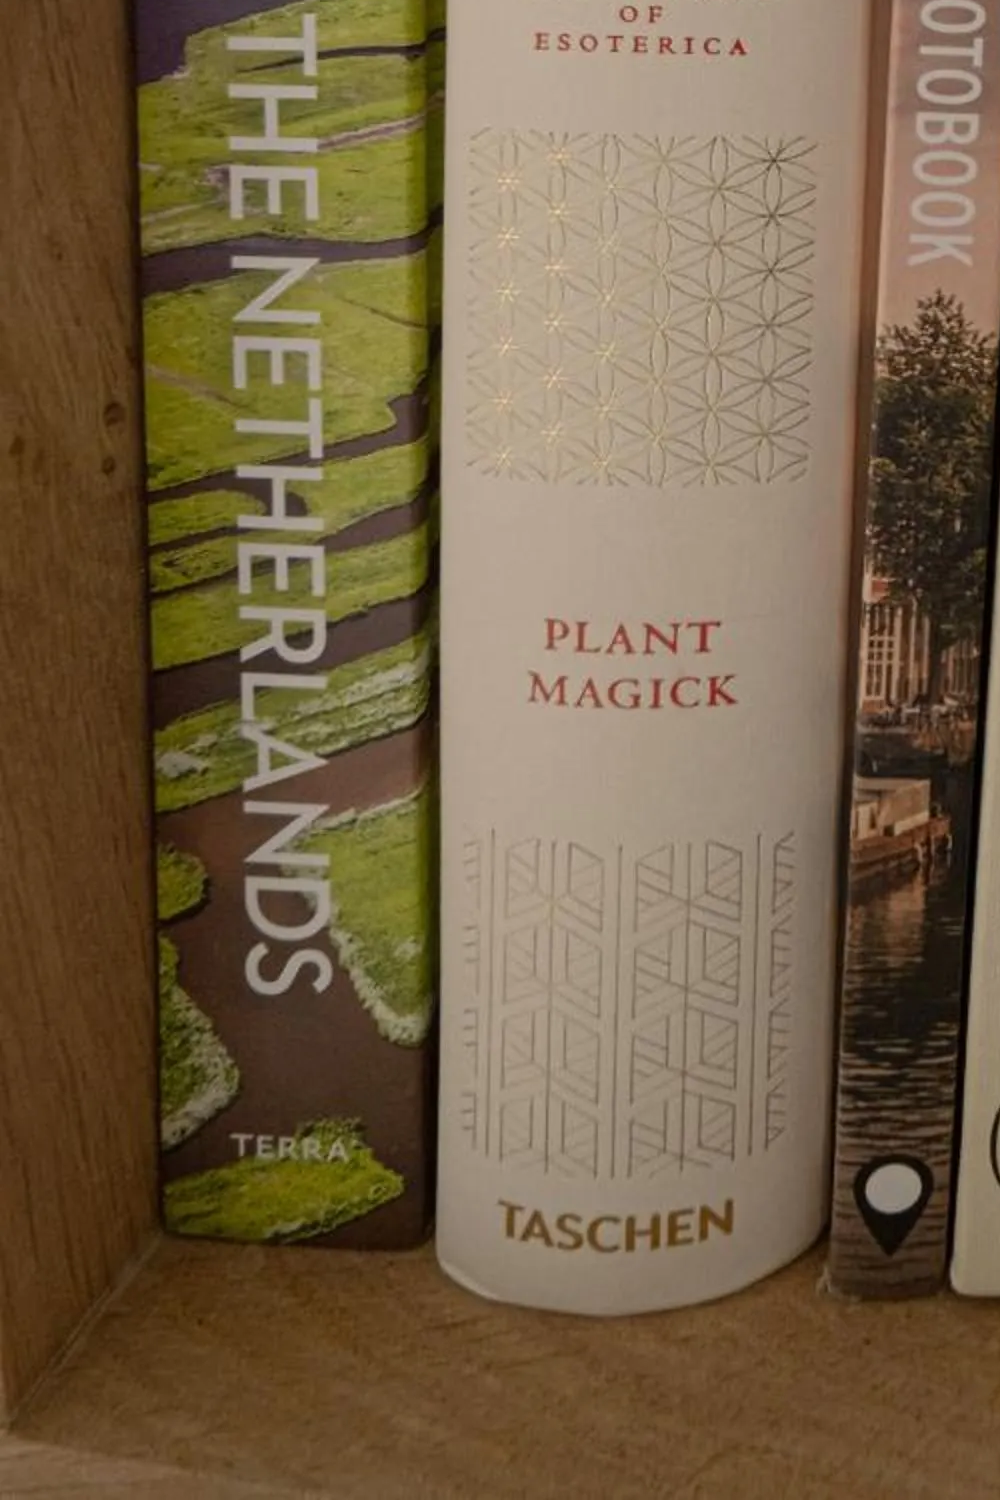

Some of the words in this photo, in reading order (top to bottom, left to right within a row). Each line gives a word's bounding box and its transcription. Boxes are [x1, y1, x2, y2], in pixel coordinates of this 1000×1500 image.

[619, 5, 665, 24] OF
[534, 32, 748, 56] ESOTERICA
[226, 13, 319, 221] THE
[229, 254, 333, 998] NETHERLANDS
[543, 617, 722, 655] PLANT
[527, 669, 739, 710] MAGICK
[229, 1131, 349, 1163] TERRA
[497, 1198, 734, 1253] TASCHEN
